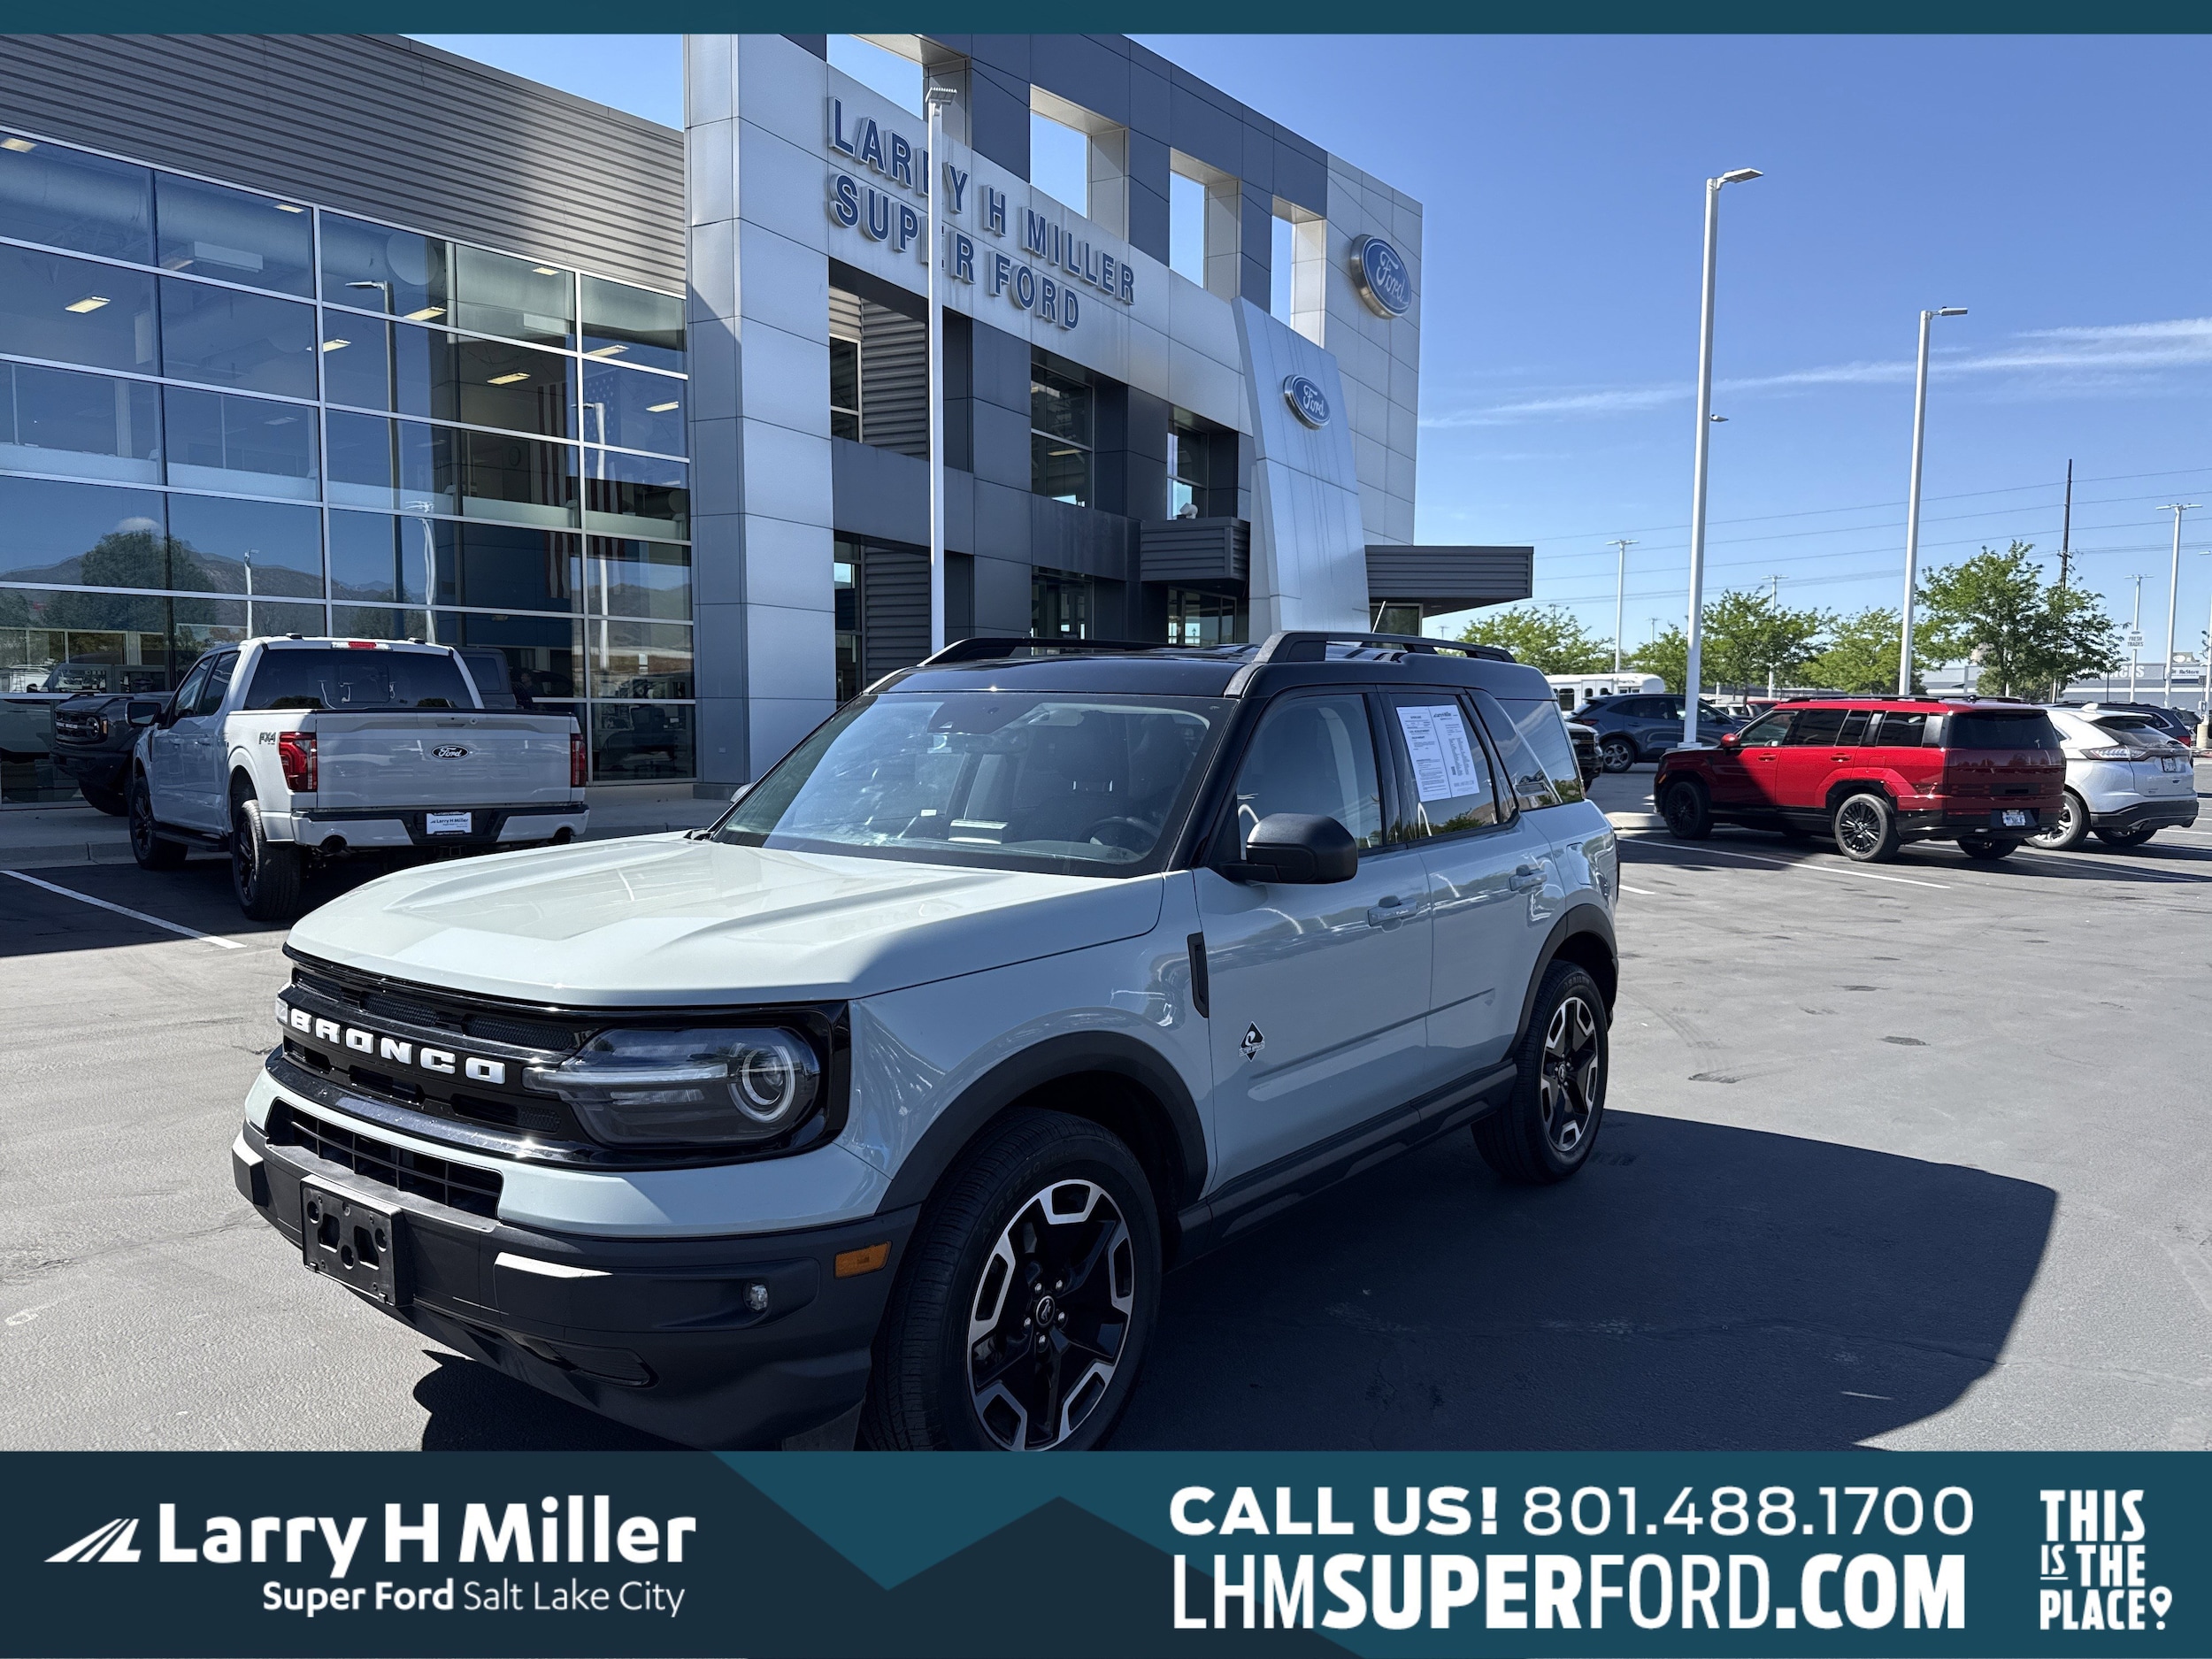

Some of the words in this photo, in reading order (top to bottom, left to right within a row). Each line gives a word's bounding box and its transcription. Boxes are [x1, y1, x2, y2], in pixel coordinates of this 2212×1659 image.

[829, 173, 975, 284] SUPR
[989, 250, 1079, 331] FORD
[983, 185, 1006, 237] H
[1021, 206, 1134, 305] MILLER
[1375, 250, 1409, 305] Ford
[1302, 384, 1325, 418] Ford
[258, 732, 277, 745] FX4
[438, 745, 463, 757] Ford
[290, 1008, 506, 1085] BRONCO
